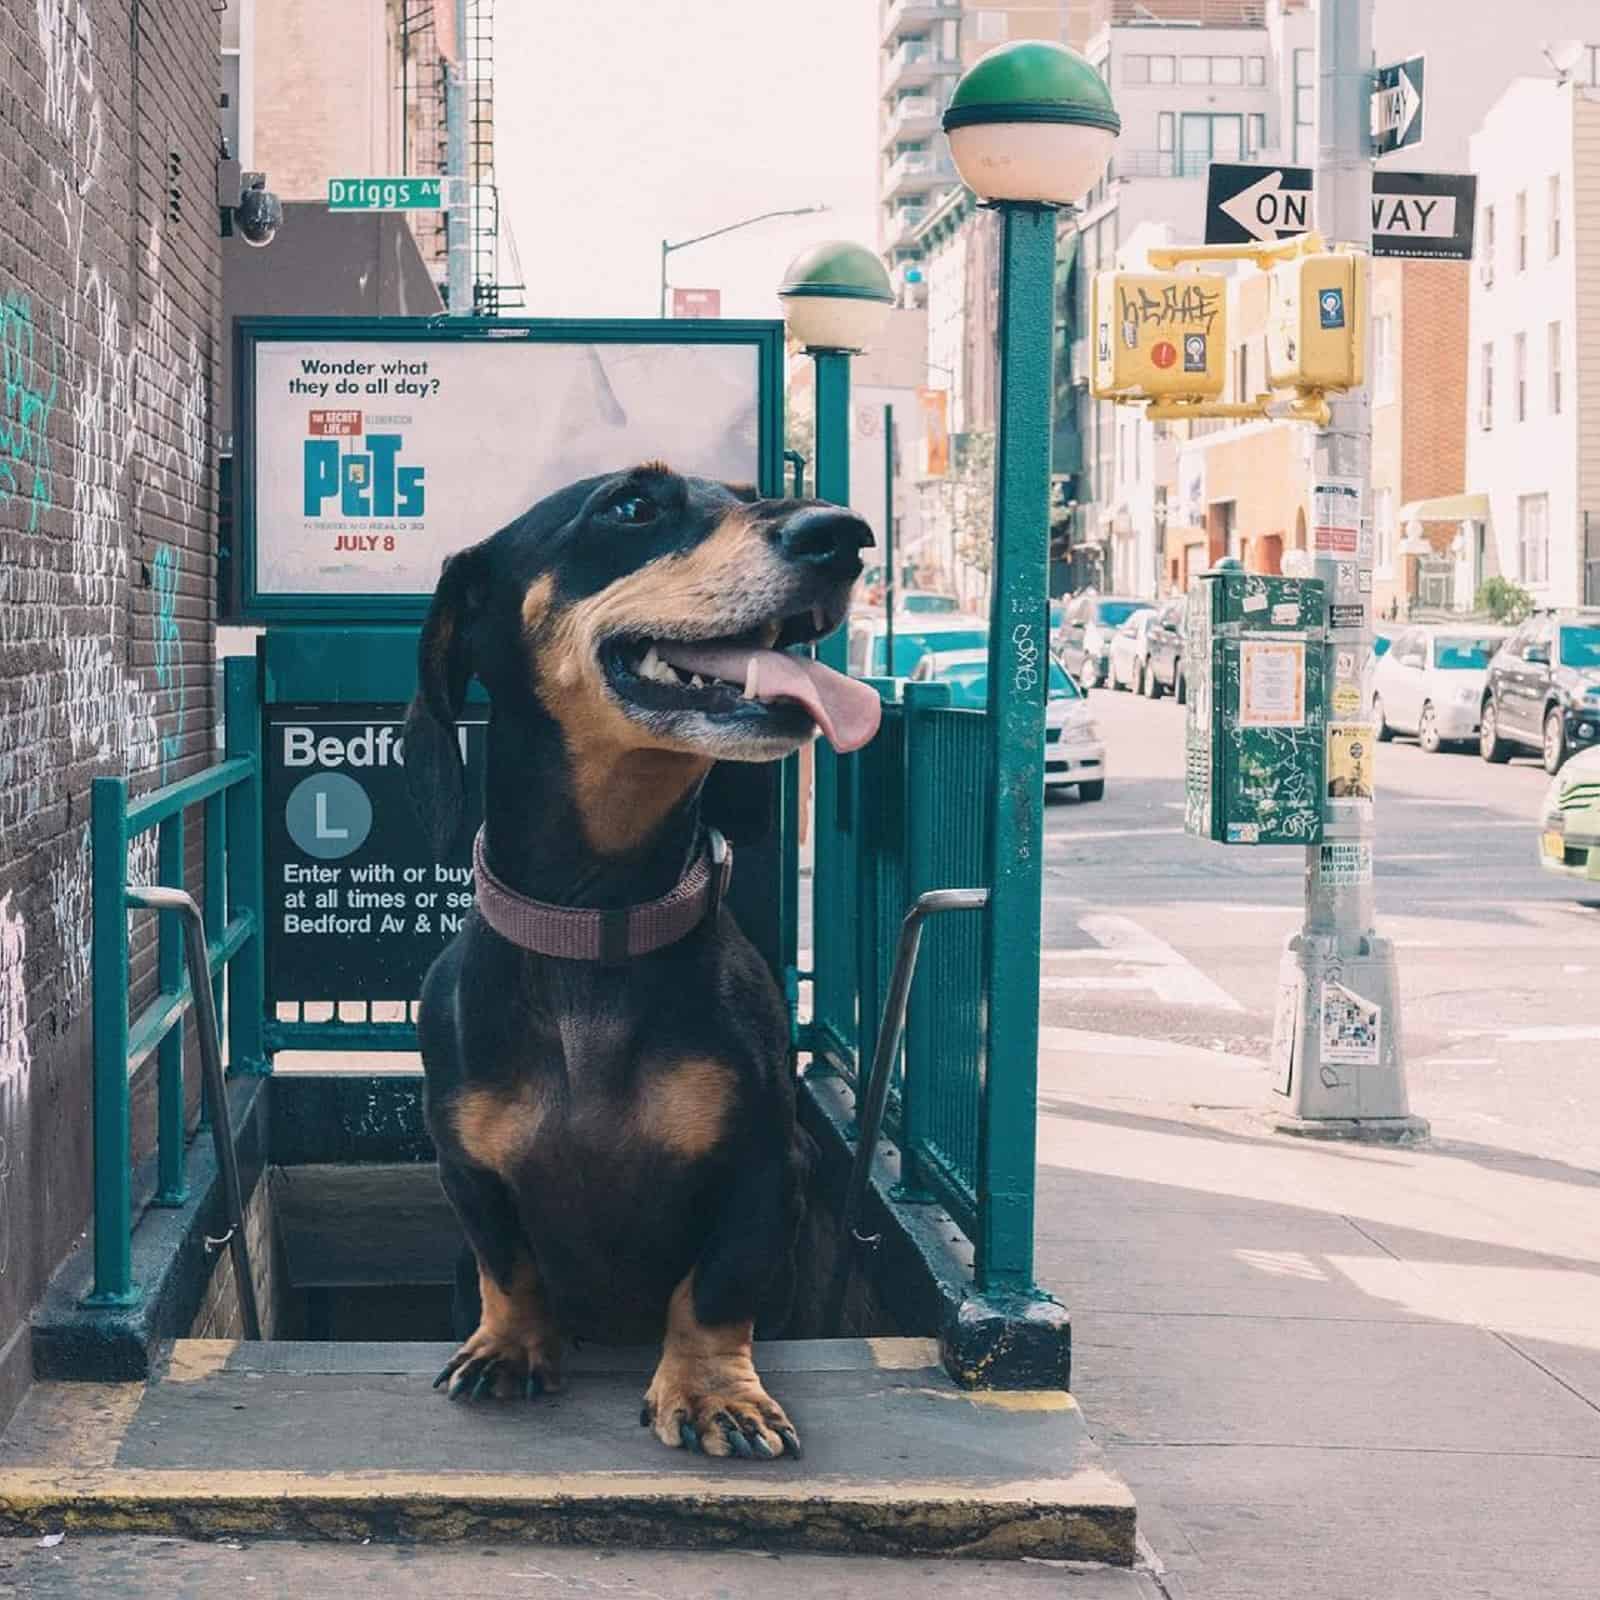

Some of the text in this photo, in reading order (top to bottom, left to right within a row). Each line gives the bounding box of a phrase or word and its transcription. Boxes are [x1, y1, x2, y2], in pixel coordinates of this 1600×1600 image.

[331, 180, 441, 208] Driggs Av
[1256, 193, 1307, 226] ON
[301, 359, 428, 375] Wonder what
[289, 378, 440, 398] they do all day?
[326, 412, 357, 424] SECRET
[324, 423, 341, 434] LIFE
[334, 535, 395, 551] JULY 8
[316, 792, 348, 839] L
[284, 864, 474, 886] Enter with or buy
[284, 889, 477, 908] at all times or se
[284, 914, 371, 933] Bedford
[380, 914, 405, 933] Av
[415, 914, 431, 933] &
